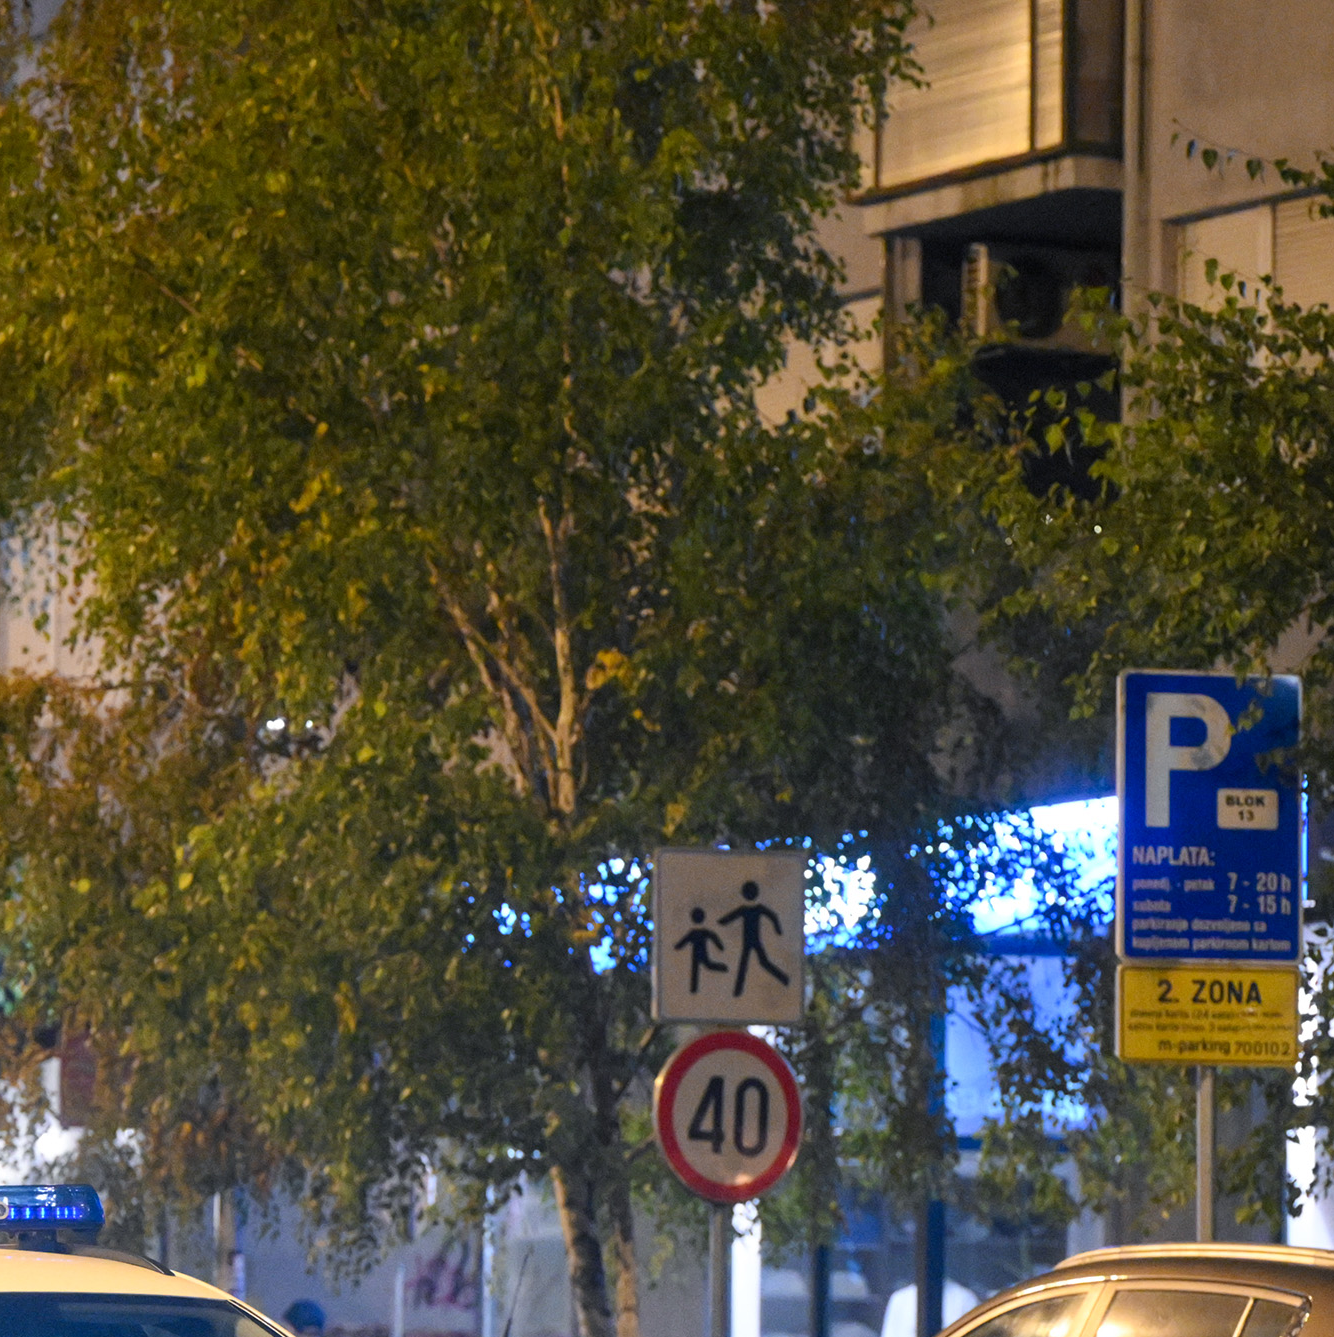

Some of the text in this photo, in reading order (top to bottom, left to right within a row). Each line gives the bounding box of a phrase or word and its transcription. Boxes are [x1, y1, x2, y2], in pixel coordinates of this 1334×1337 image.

[1145, 692, 1232, 828] P
[1225, 795, 1266, 807] BLOK
[1238, 810, 1255, 821] 13
[1132, 846, 1216, 867] NAPLATA:
[1227, 872, 1238, 892] 7
[1256, 872, 1279, 892] 20
[1280, 873, 1292, 893] h
[1227, 894, 1238, 913] 7
[1257, 894, 1277, 914] 15
[1280, 895, 1292, 915] h
[1157, 979, 1262, 1004] 2. ZONA
[1234, 1041, 1291, 1057] 700102
[688, 1075, 770, 1158] 40
